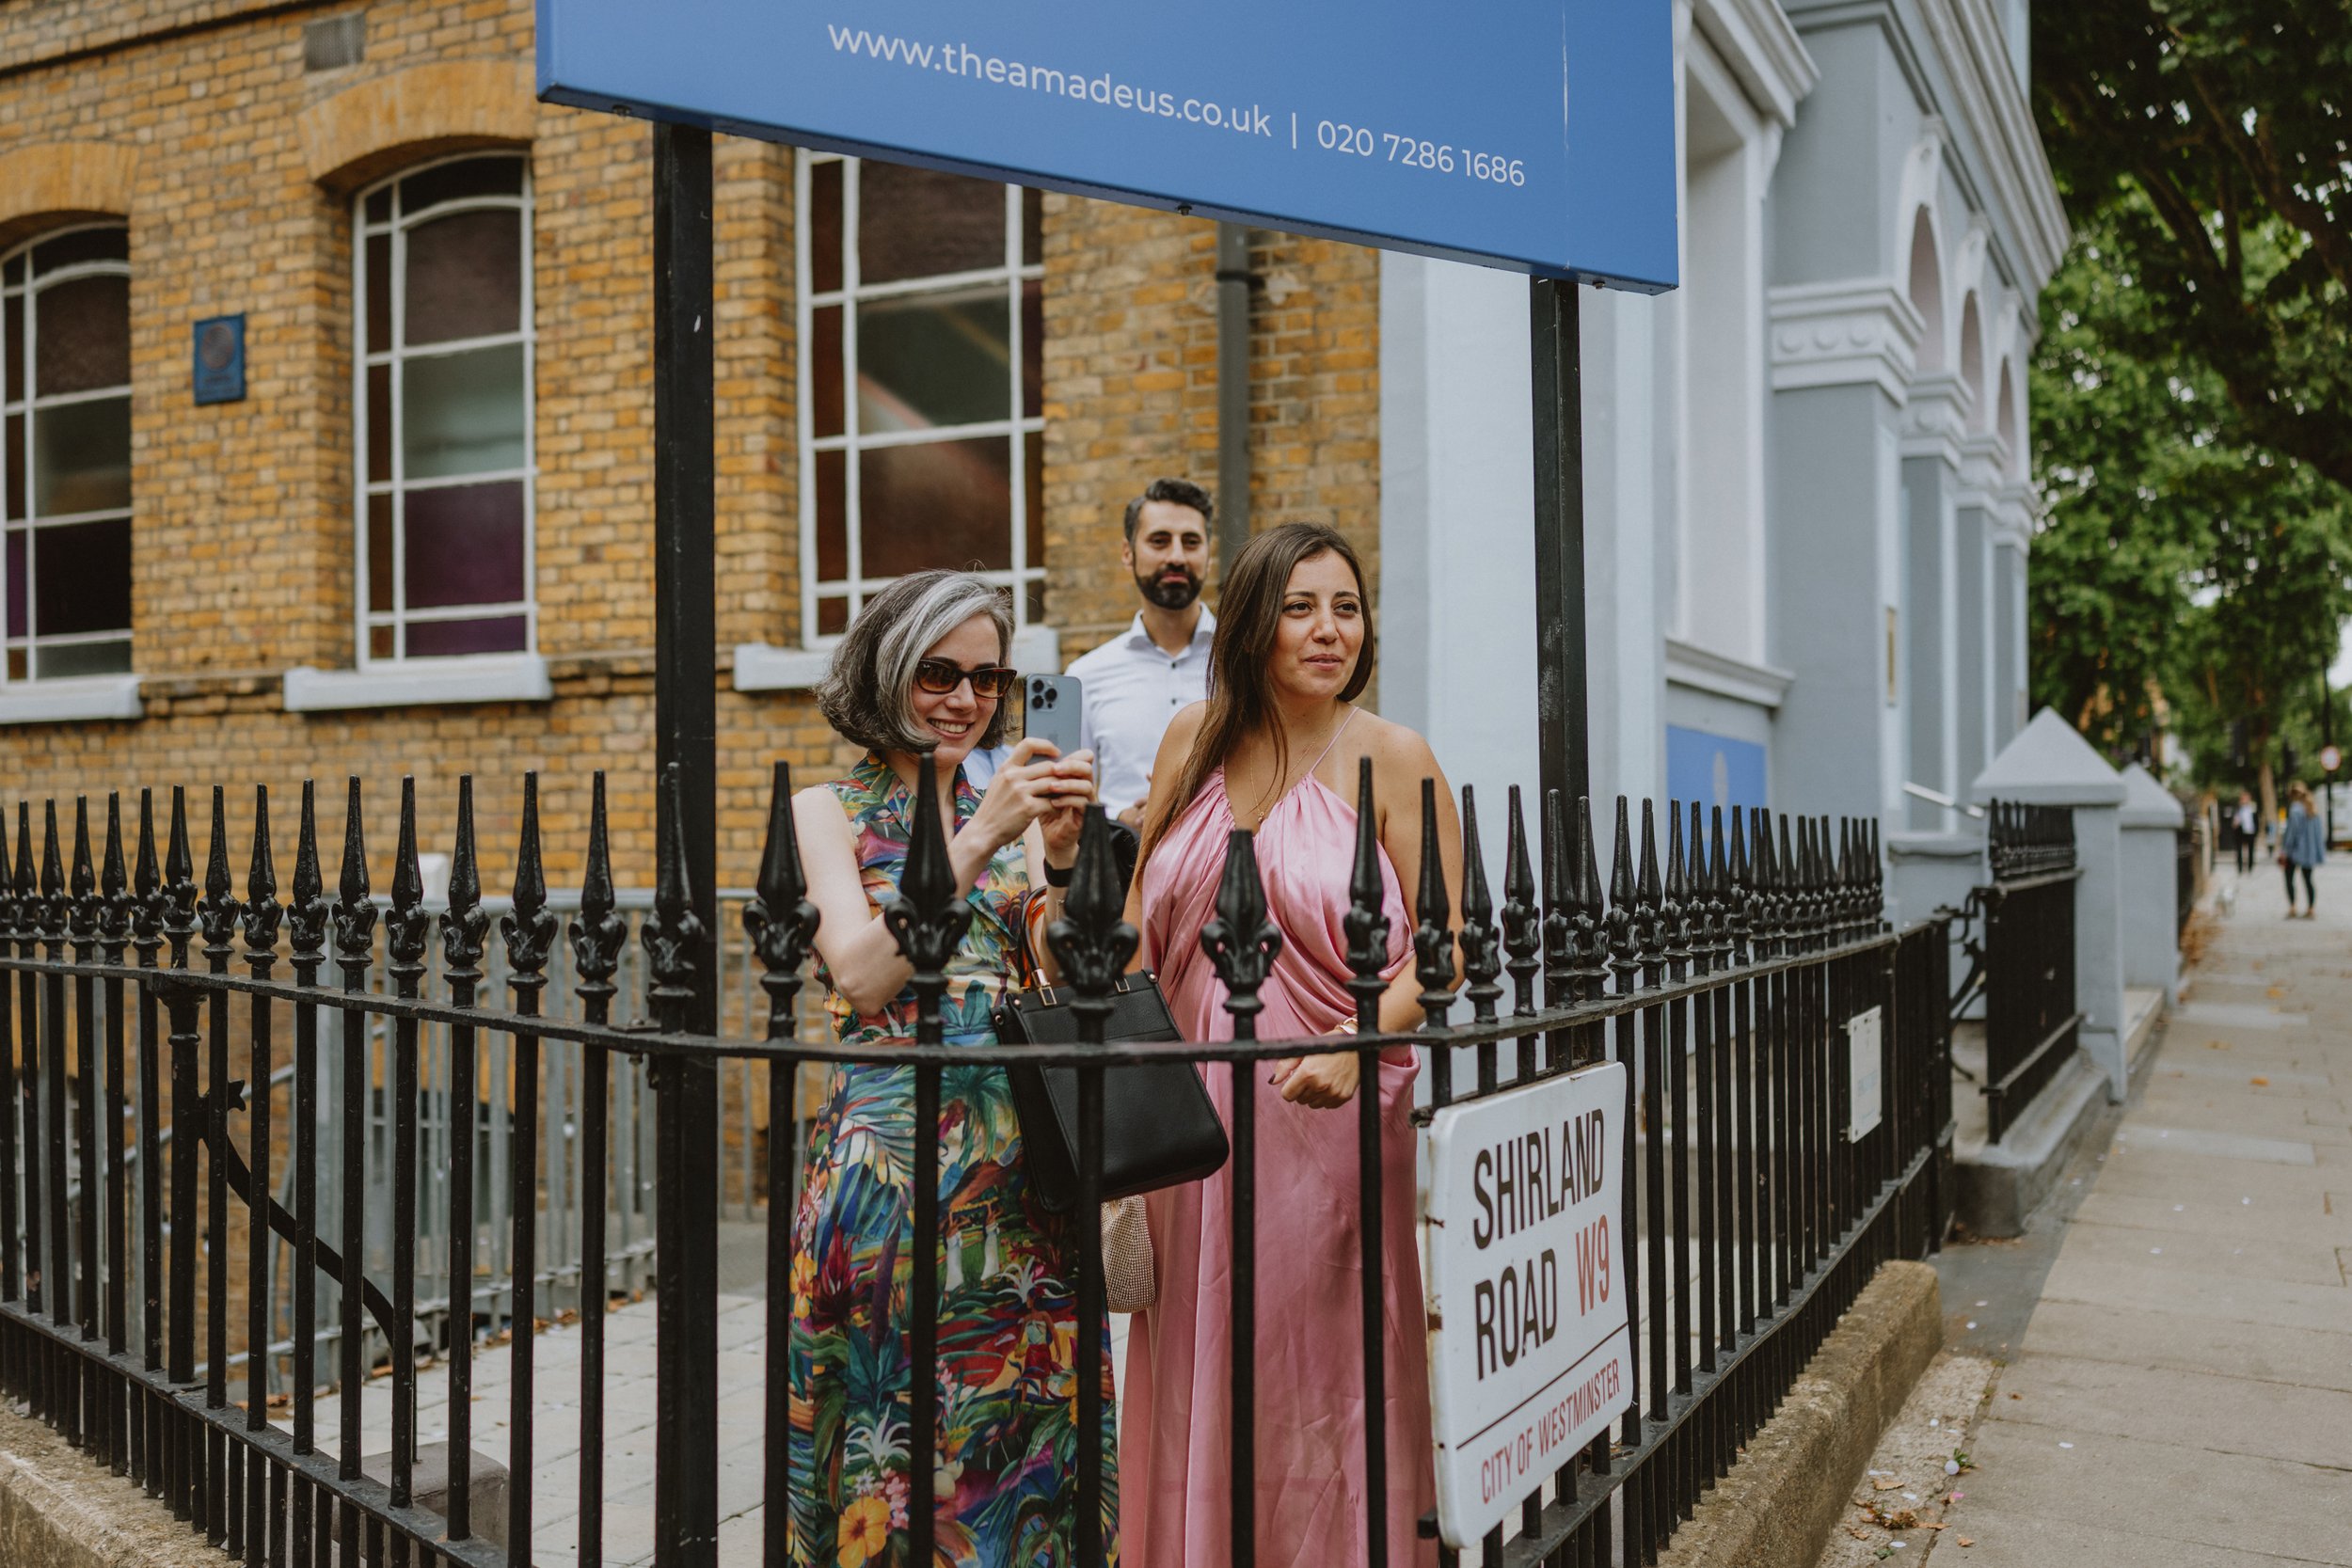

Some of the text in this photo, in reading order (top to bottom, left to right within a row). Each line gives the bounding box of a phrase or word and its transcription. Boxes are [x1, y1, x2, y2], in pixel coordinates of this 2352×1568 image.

[828, 24, 1272, 137] www.theamadeus.co.uk
[1317, 119, 1374, 157] 020
[1383, 133, 1454, 173] 7286
[1462, 149, 1525, 187] 1686
[1473, 1109, 1604, 1249] SHIRLAND
[1475, 1215, 1610, 1381] ROAD W9
[1482, 1357, 1620, 1505] CITY OF WESTMINSTER
